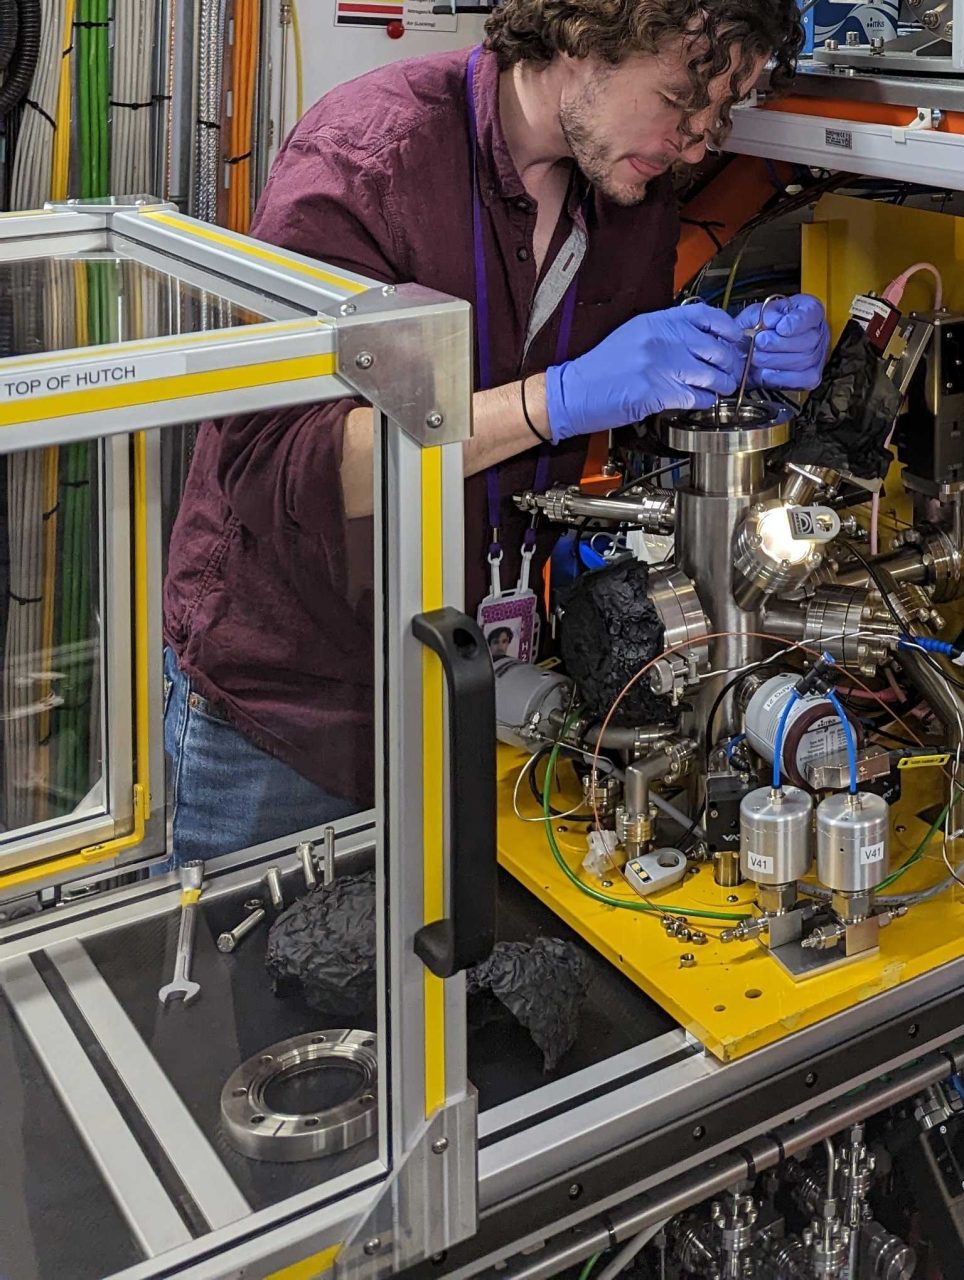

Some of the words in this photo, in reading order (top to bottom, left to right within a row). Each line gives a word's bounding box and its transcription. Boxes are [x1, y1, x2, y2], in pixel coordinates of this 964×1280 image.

[4, 379, 41, 397] TOP
[46, 374, 71, 391] OF
[76, 364, 136, 387] HUTCH
[865, 847, 881, 860] V41
[750, 856, 767, 870] V41
